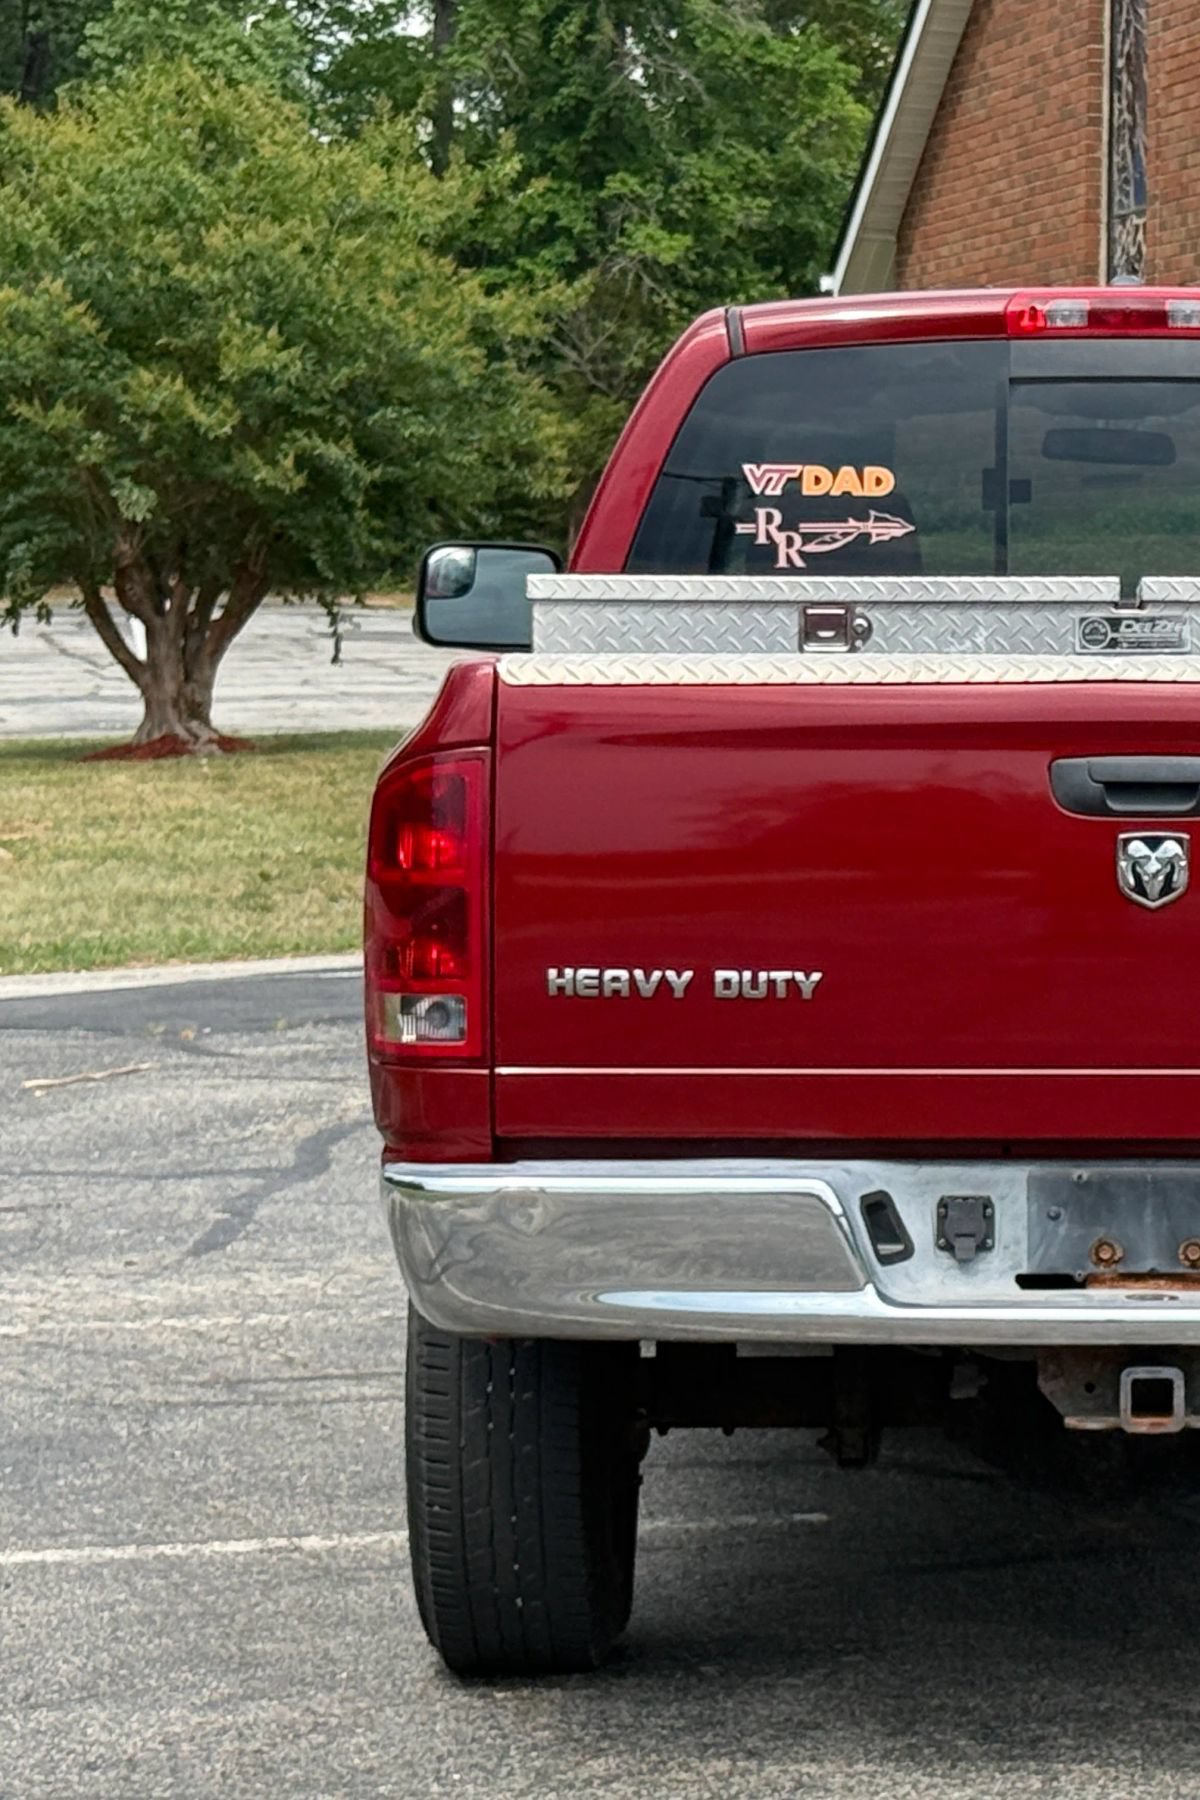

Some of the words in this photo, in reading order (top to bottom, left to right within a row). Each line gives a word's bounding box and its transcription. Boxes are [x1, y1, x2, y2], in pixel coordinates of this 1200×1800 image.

[802, 465, 896, 497] DAD
[547, 967, 694, 998] HEAVY
[714, 969, 823, 999] DUTY
